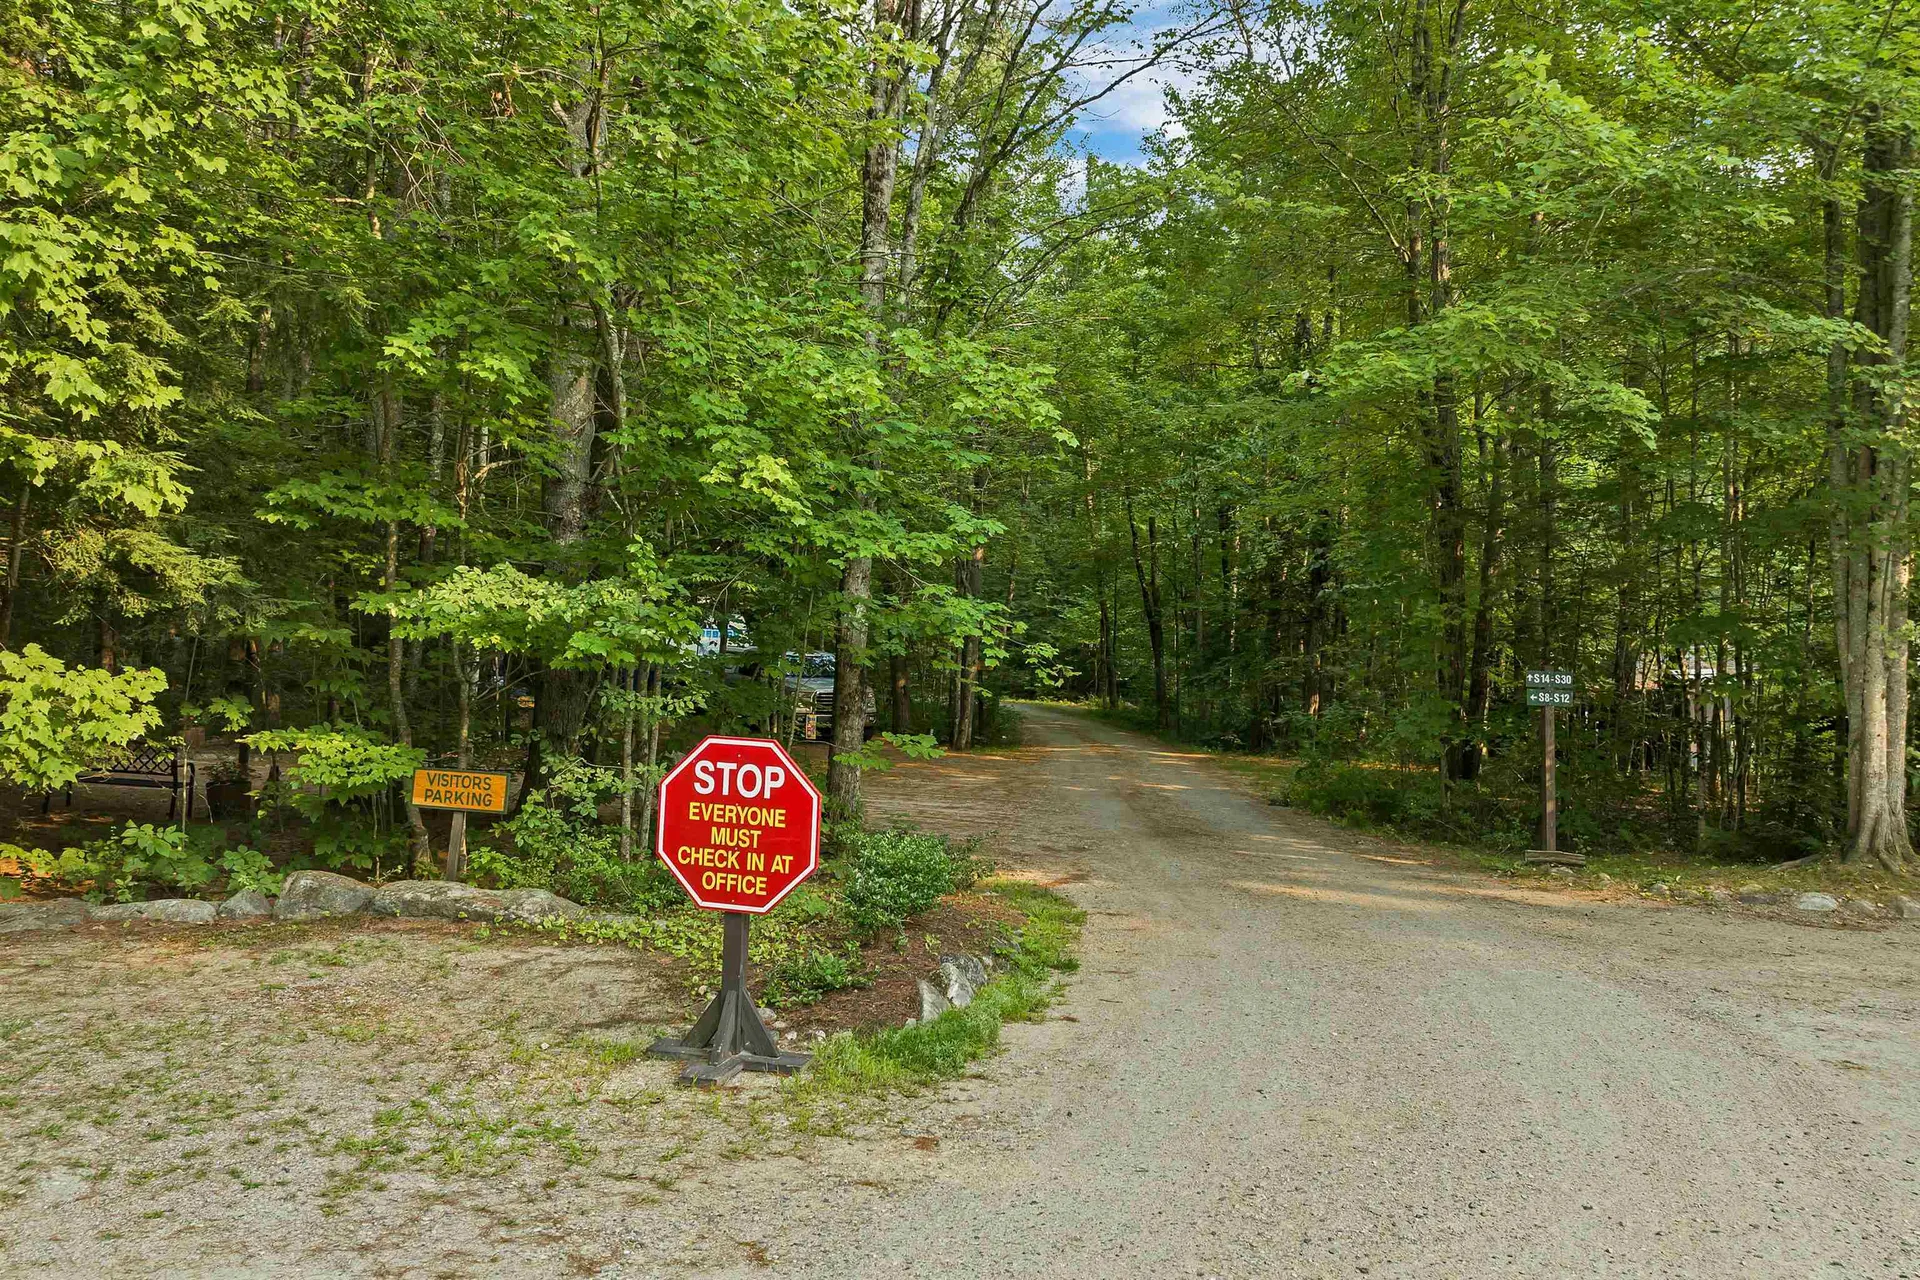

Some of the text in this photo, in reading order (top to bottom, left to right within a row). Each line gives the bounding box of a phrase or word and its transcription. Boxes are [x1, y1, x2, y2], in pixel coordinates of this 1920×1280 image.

[1534, 673, 1572, 685] S14-S30
[1538, 692, 1570, 703] S8-S12
[427, 772, 492, 791] VISITORS
[693, 760, 785, 799] STOP
[424, 788, 492, 807] PARKING
[689, 802, 786, 828] EVERYONE
[710, 826, 761, 848] MUST
[677, 846, 793, 874] CHECK IN AT
[702, 871, 767, 896] OFFICE
